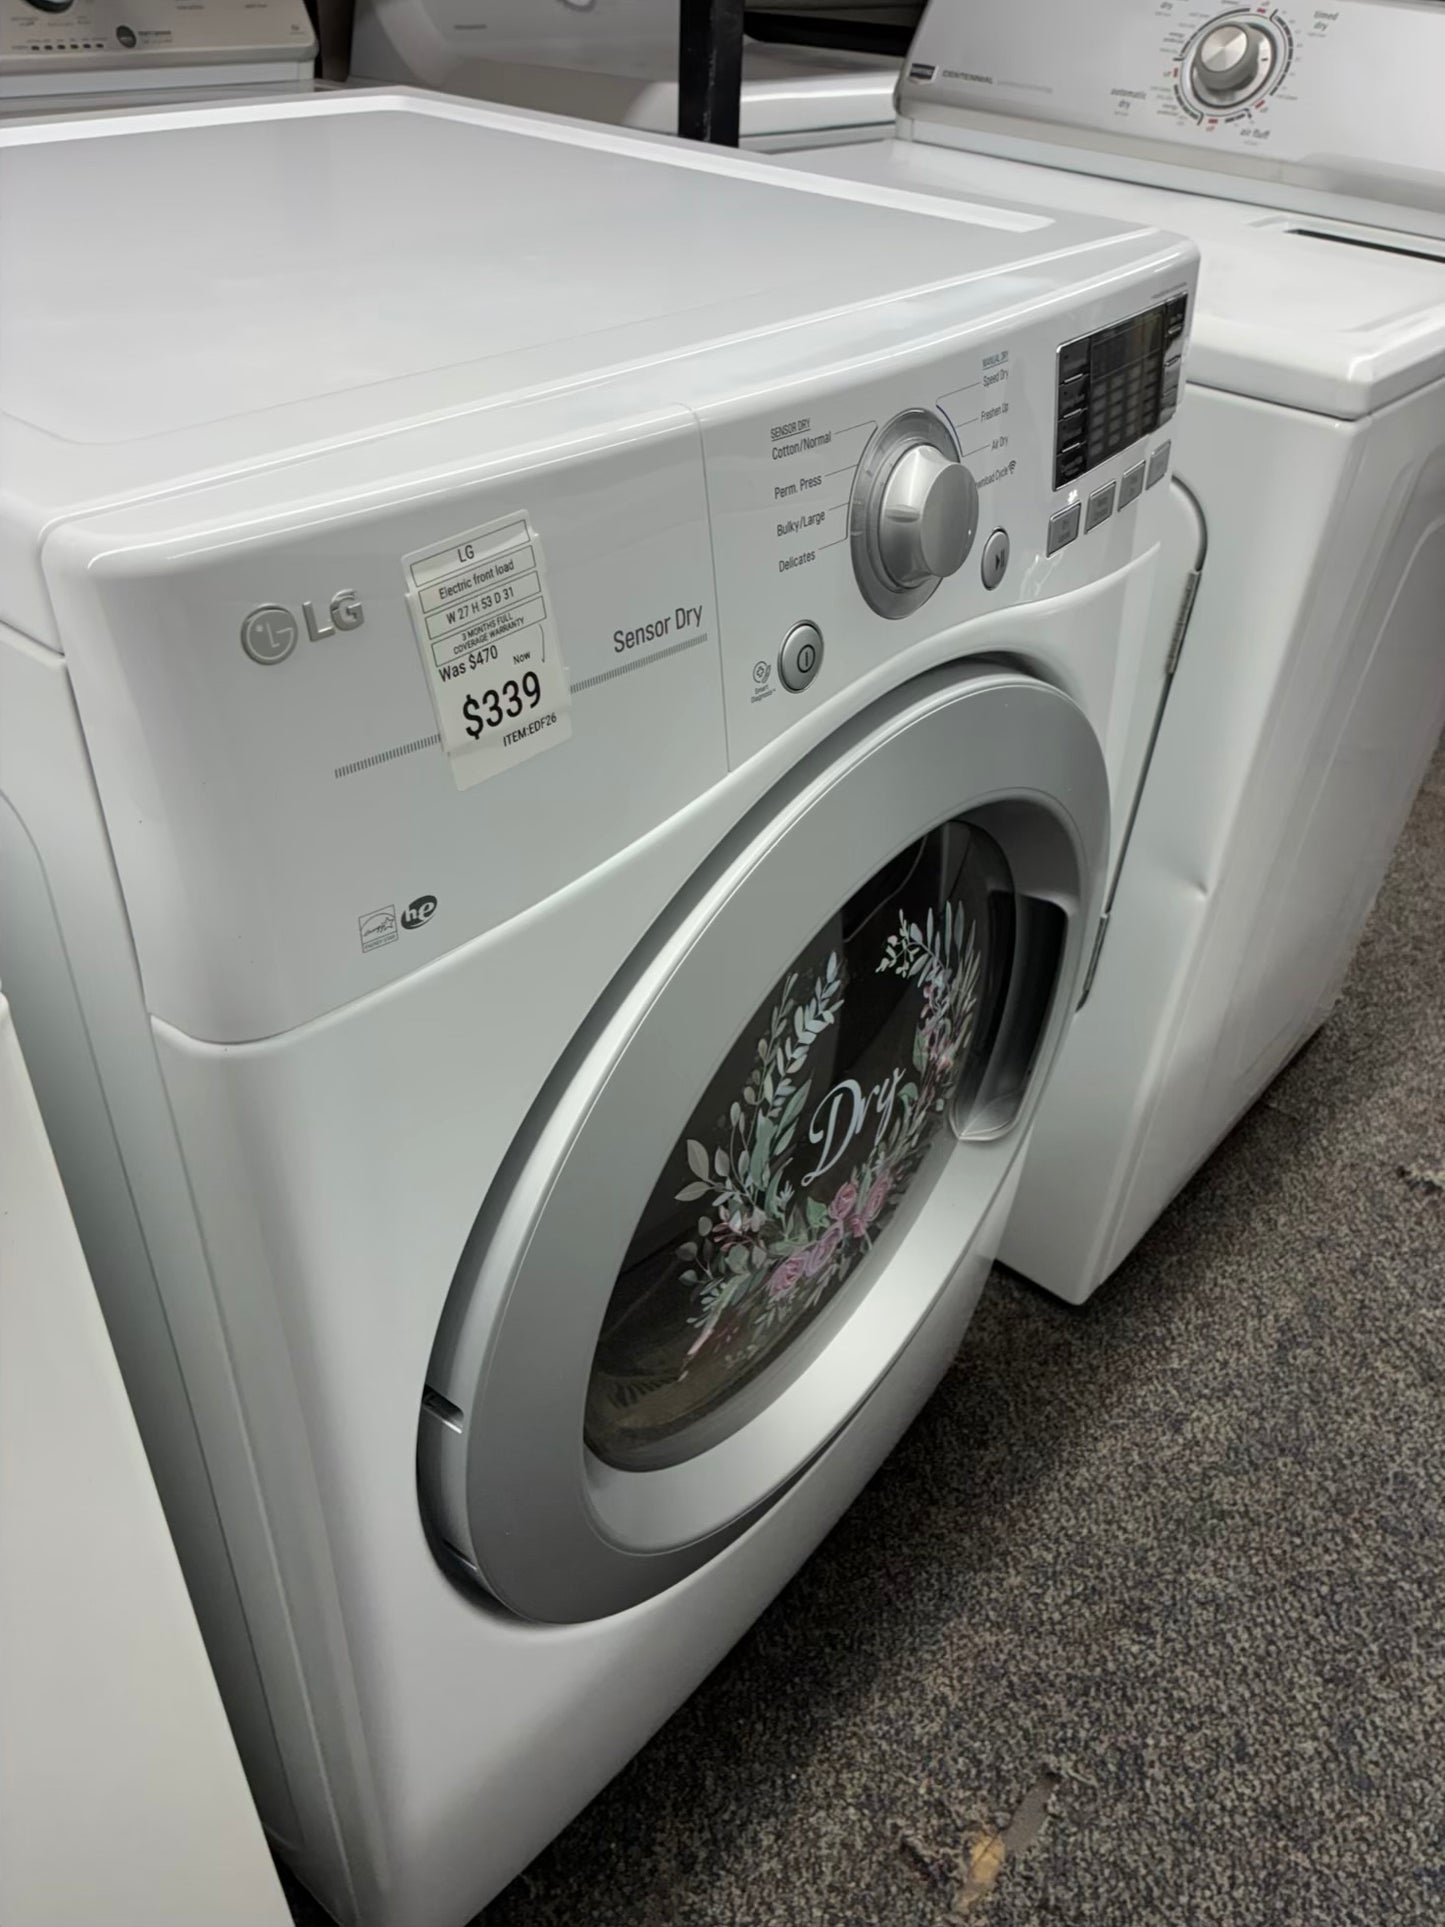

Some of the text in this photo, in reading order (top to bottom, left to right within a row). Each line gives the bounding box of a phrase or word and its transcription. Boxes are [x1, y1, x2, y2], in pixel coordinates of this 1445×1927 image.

[770, 418, 811, 439] SENSOR DRY
[772, 431, 832, 460] Cotton/Normal
[774, 474, 822, 499] Perm. Press
[776, 511, 826, 537] Bulky/Large
[457, 544, 475, 563] LG
[778, 550, 816, 573] Delicates
[438, 558, 515, 600] Electric front load
[302, 588, 365, 642] LG
[446, 586, 515, 625] W 27 H 53 D 31
[453, 617, 525, 656] COVERAGE WARRANTY
[466, 619, 497, 638] MONTHS
[496, 612, 513, 626] FULL
[612, 605, 704, 654] Sensor Dry
[439, 644, 499, 683] Was $470
[512, 650, 532, 666] Now
[462, 671, 542, 740] $339
[502, 712, 558, 748] ITEM:EDF26
[801, 1067, 907, 1187] Dry
